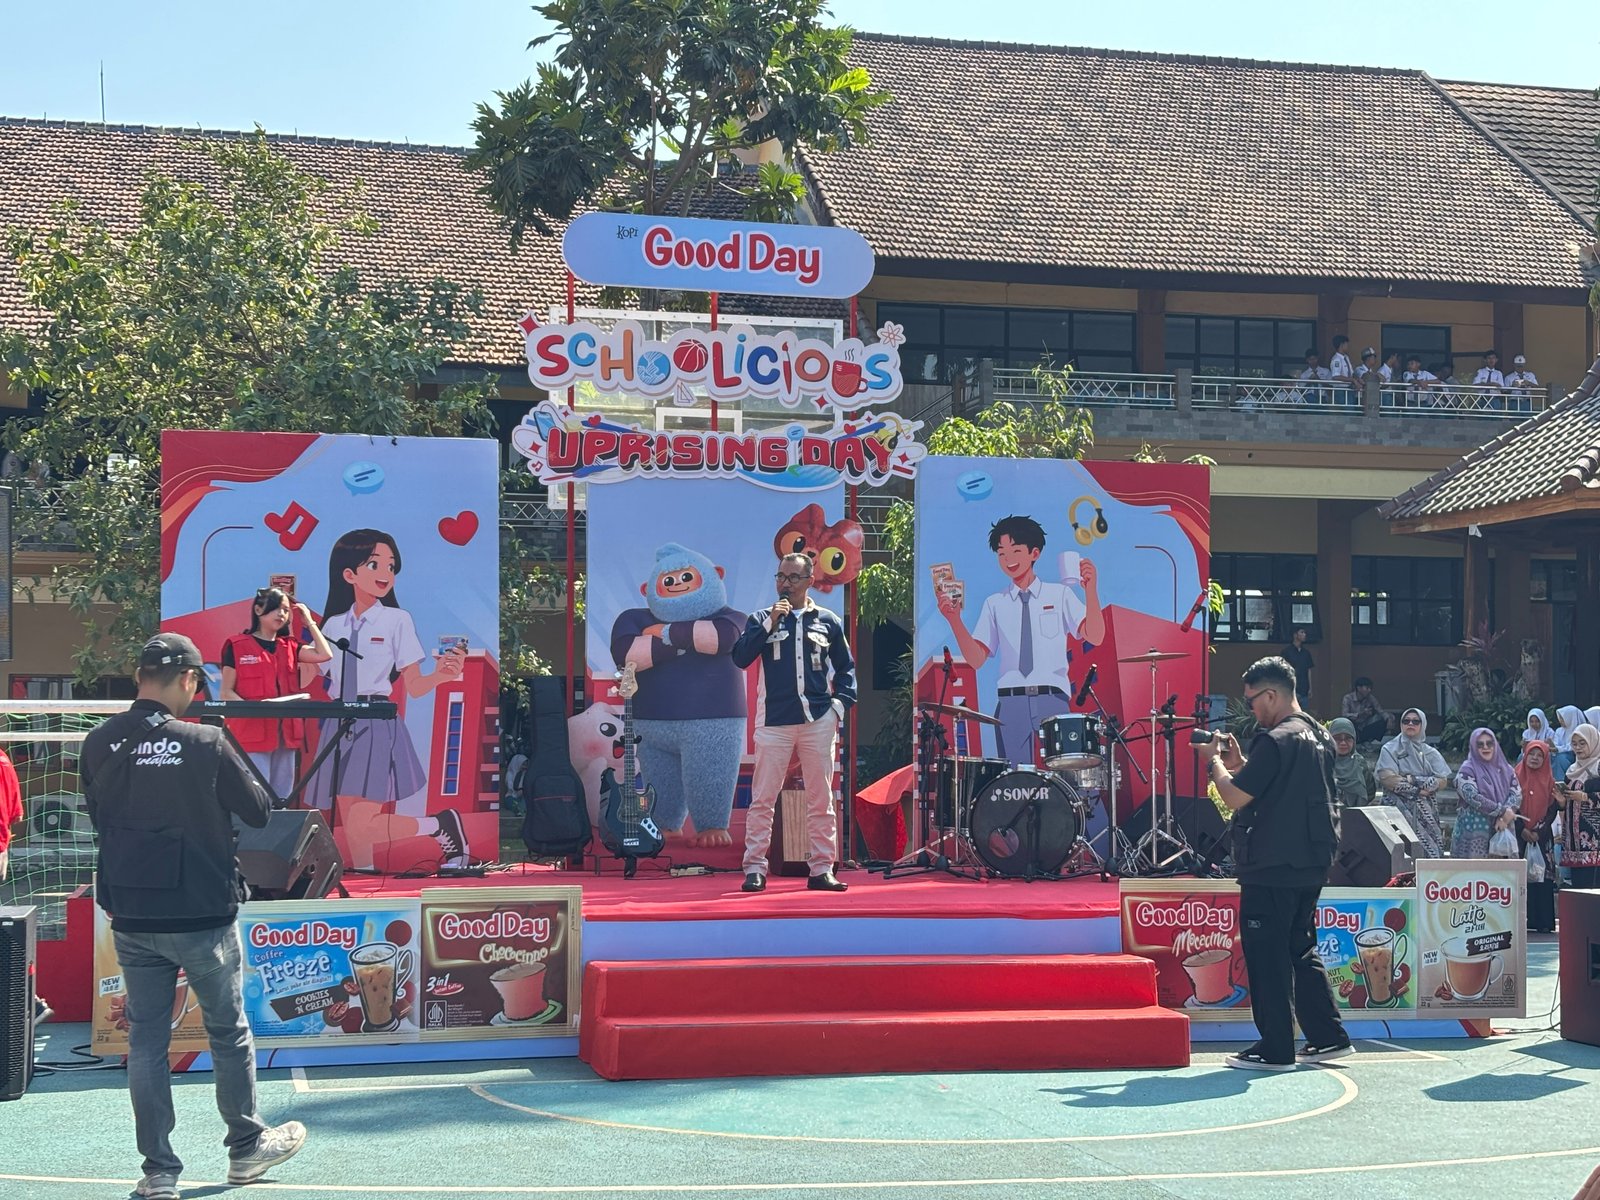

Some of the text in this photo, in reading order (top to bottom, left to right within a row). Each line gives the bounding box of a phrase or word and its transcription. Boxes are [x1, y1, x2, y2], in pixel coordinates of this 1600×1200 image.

[644, 225, 742, 272] Good
[747, 232, 821, 284] Day
[546, 427, 894, 477] UPRISING DAY
[136, 750, 184, 767] creative
[1003, 787, 1049, 801] SONOR
[1424, 880, 1472, 903] Good
[1475, 881, 1512, 907] Day
[438, 912, 501, 940] Good
[503, 911, 550, 943] Day
[1136, 901, 1234, 931] Good Day
[1323, 906, 1360, 934] Day
[1450, 905, 1486, 928] Latte
[250, 922, 357, 950] Good Day
[1172, 928, 1233, 957] Mocacinno
[1474, 935, 1505, 946] ORIGINAL
[254, 949, 283, 963] Coffee
[479, 943, 548, 964] Chococinno
[1423, 950, 1438, 959] NEW
[101, 976, 120, 987] NEW
[256, 955, 330, 994] Freeze
[295, 989, 330, 1005] COOKIES
[305, 997, 335, 1012] CREAM
